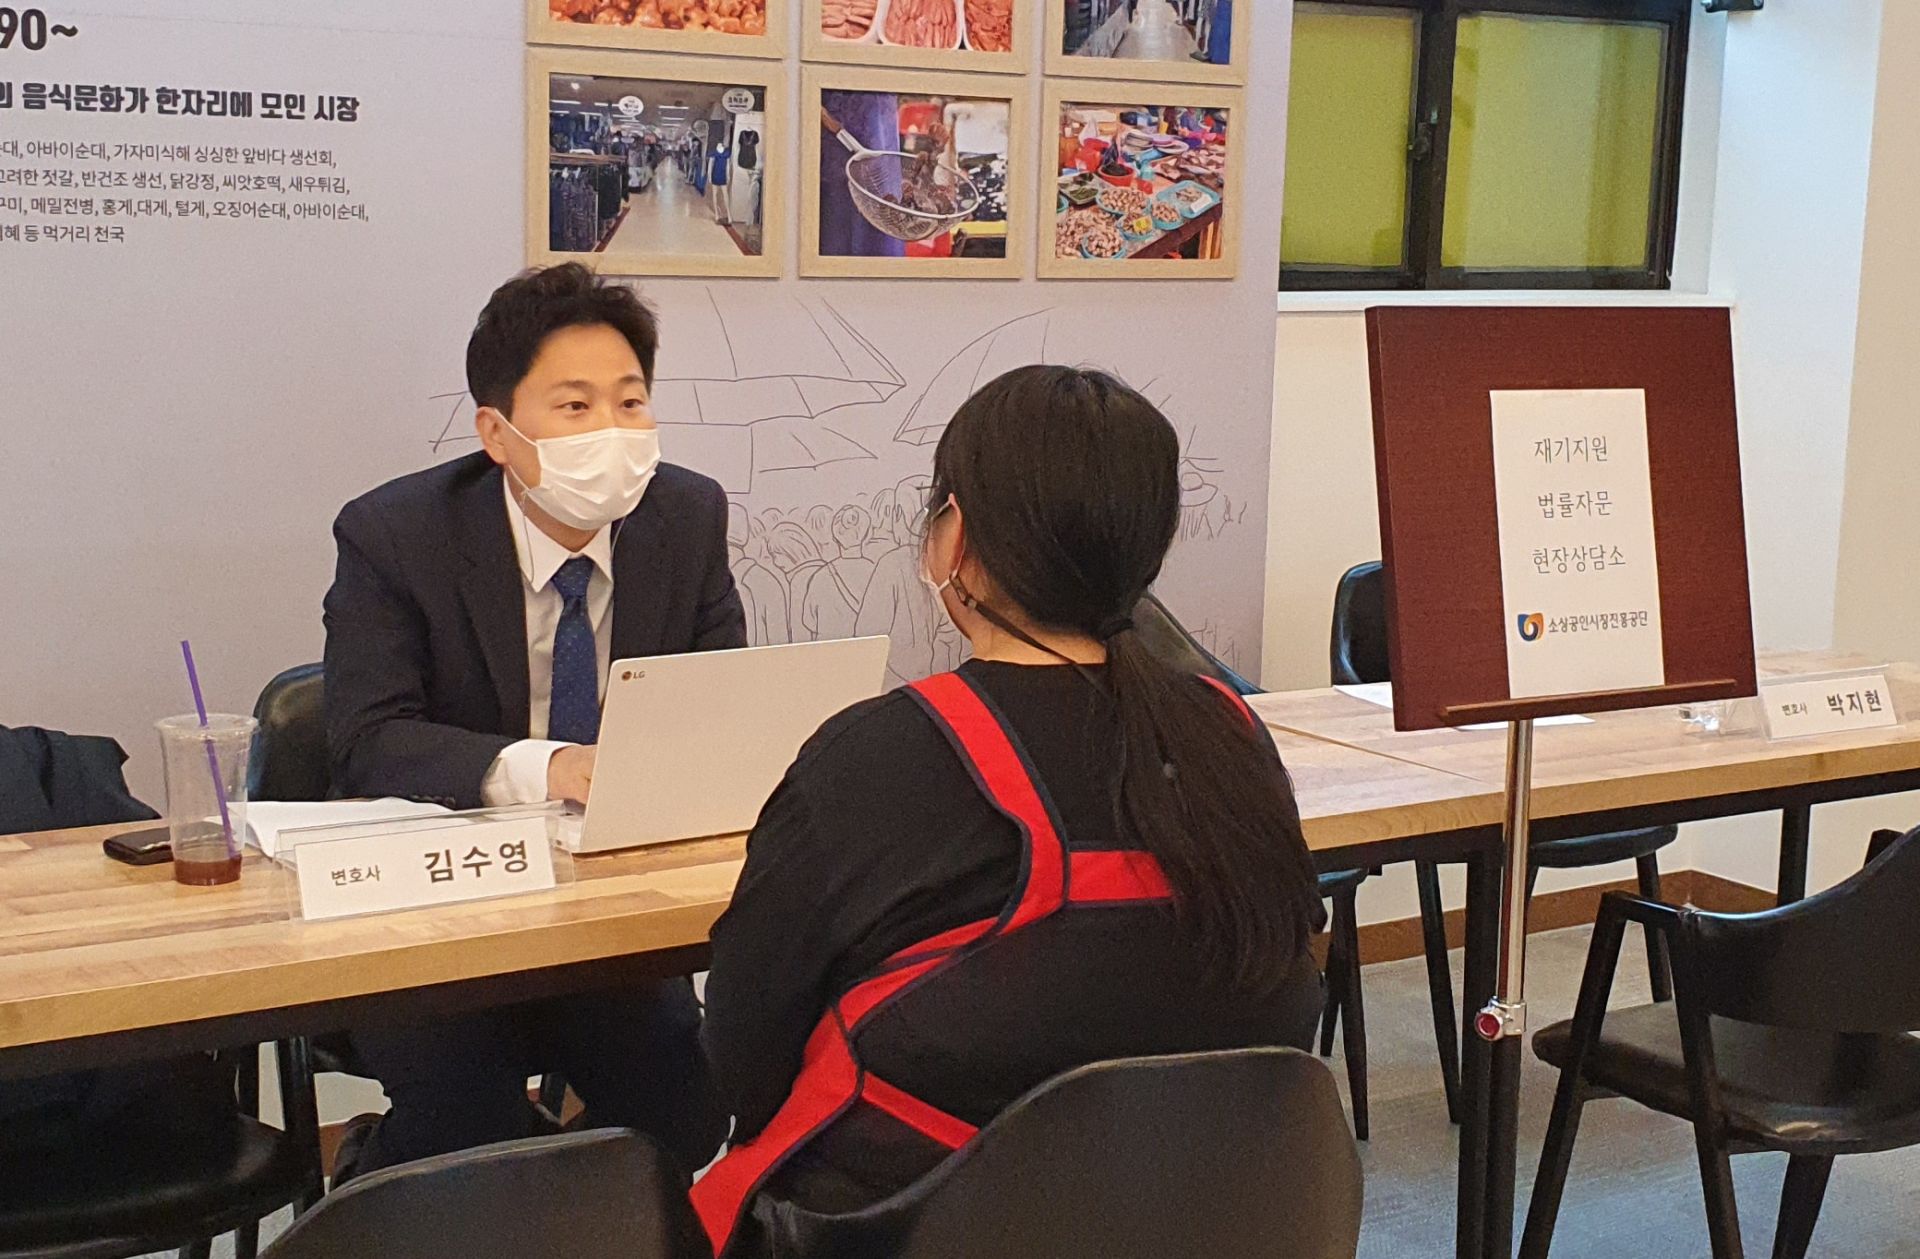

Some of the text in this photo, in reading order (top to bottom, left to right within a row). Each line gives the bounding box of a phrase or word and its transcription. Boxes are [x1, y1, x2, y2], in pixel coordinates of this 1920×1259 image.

[22, 83, 149, 114] 음식문화가
[156, 87, 253, 118] 한자리에
[260, 92, 306, 121] 모인
[313, 95, 360, 122] 시장
[27, 141, 111, 161] 아바이순대,
[114, 143, 190, 162] 가자미식해
[194, 146, 238, 164] 싱싱한
[242, 148, 285, 166] 앞바다
[289, 150, 337, 168] 생선회,
[42, 169, 78, 188] 젓갈,
[81, 171, 128, 188] 반건조
[132, 172, 166, 190] 생선,
[170, 173, 219, 192] 닭강정,
[223, 174, 286, 194] 씨앗호떡,
[289, 176, 350, 195] 새우튀김,
[31, 198, 98, 216] 메밀전병,
[176, 201, 209, 219] 털게,
[213, 201, 290, 220] 오징어순대,
[293, 203, 369, 222] 아바이순대,
[24, 225, 39, 242] 등
[43, 225, 90, 243] 먹거리
[94, 226, 125, 243] 천국
[1533, 435, 1608, 465] 재기지원
[1538, 490, 1613, 519] 법률자문
[1532, 545, 1626, 575] 현장상담소
[1548, 610, 1649, 634] 소상공인시장진흥공단
[633, 670, 646, 680] LG
[1781, 689, 1882, 717] 변호사 박지현
[331, 839, 529, 886] 변호사 김수영
